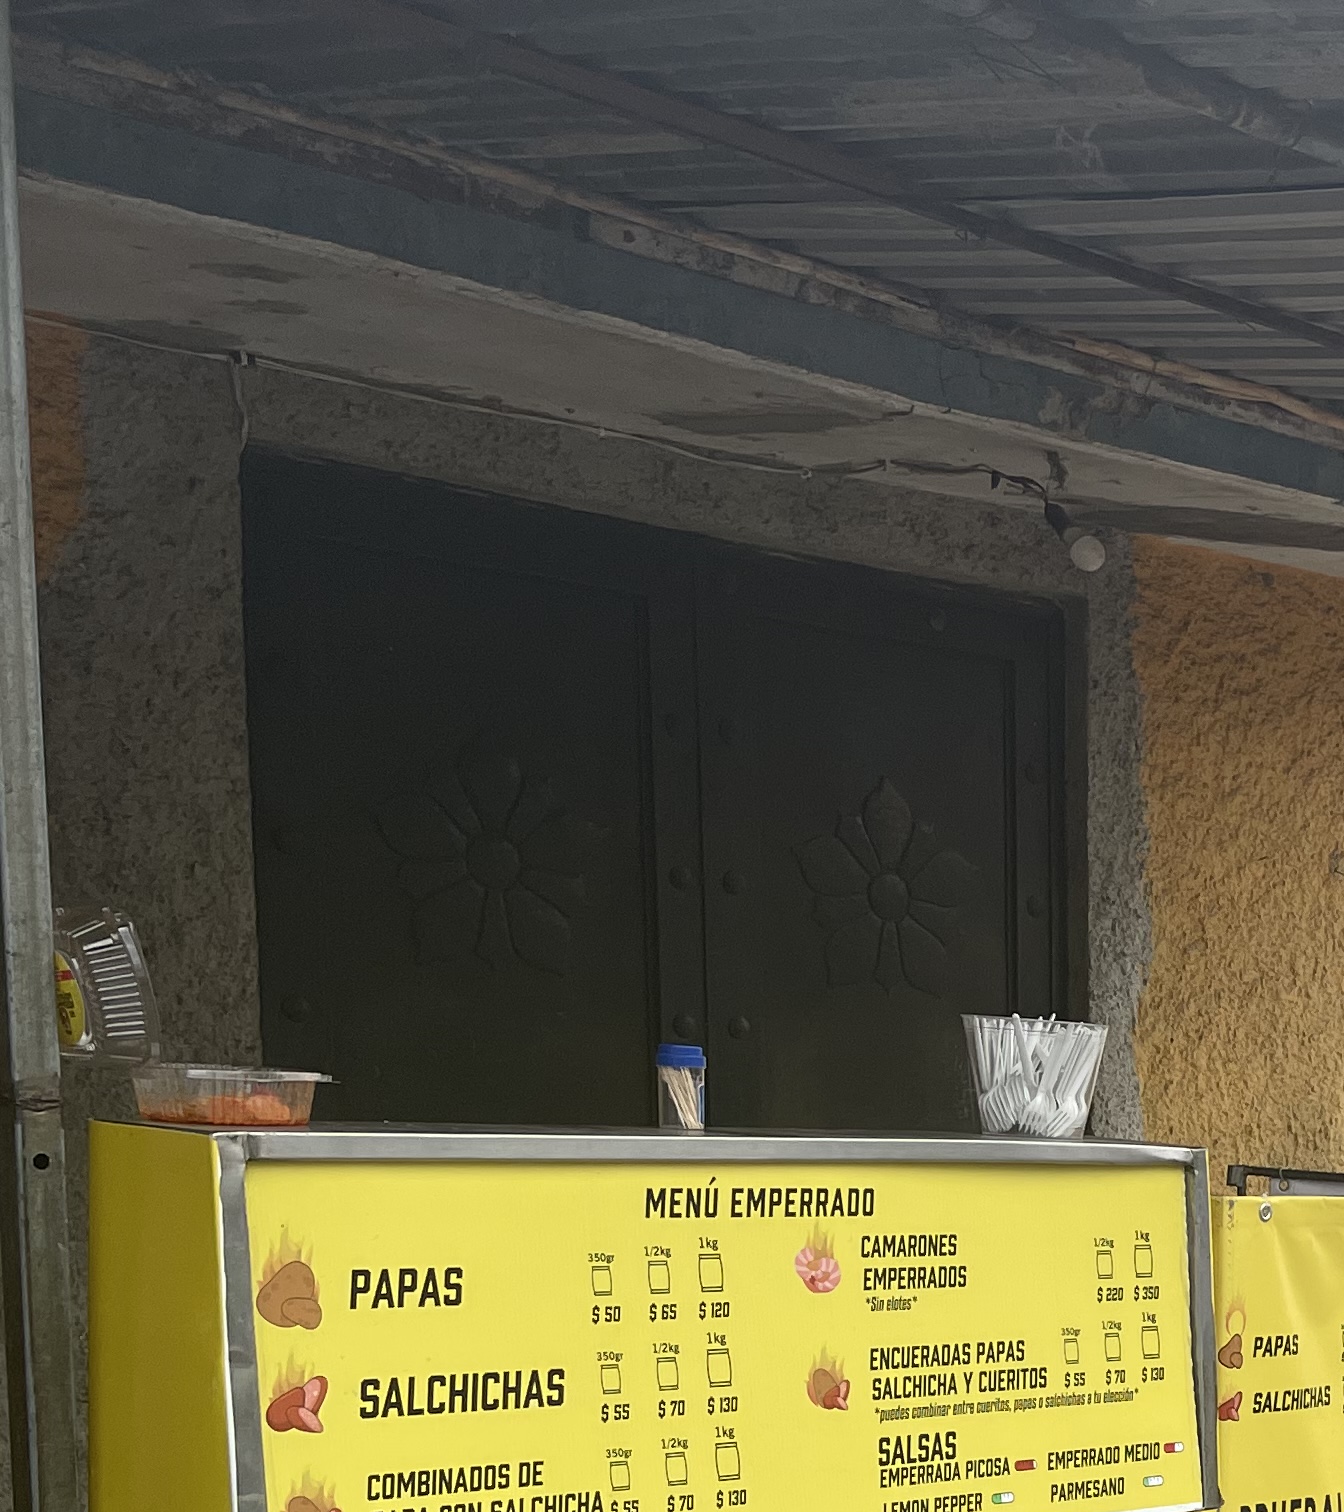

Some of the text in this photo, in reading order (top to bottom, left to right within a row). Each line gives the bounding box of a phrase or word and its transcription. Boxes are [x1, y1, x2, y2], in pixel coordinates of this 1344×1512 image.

[645, 1177, 874, 1218] MENÚ EMPERRADO
[861, 1234, 957, 1258] CAMARONES
[350, 1267, 463, 1309] PAPAS
[864, 1266, 966, 1290] EMPERRADOS
[870, 1340, 1024, 1370] ENCUERADAS PAPAS
[1253, 1334, 1298, 1357] PAPAS
[360, 1369, 565, 1419] SALCHICHAS
[872, 1367, 1047, 1400] SALCHICHA Y CUERITOS
[1253, 1386, 1330, 1413] SALCHICHAS
[879, 1431, 956, 1466] SALSAS
[1048, 1442, 1160, 1470] EMPERRADO MEDIO
[367, 1461, 544, 1501] COMBINADOS DE
[880, 1457, 1010, 1488] EMPERRADA PICOSA
[1051, 1477, 1124, 1503] PARMESANO
